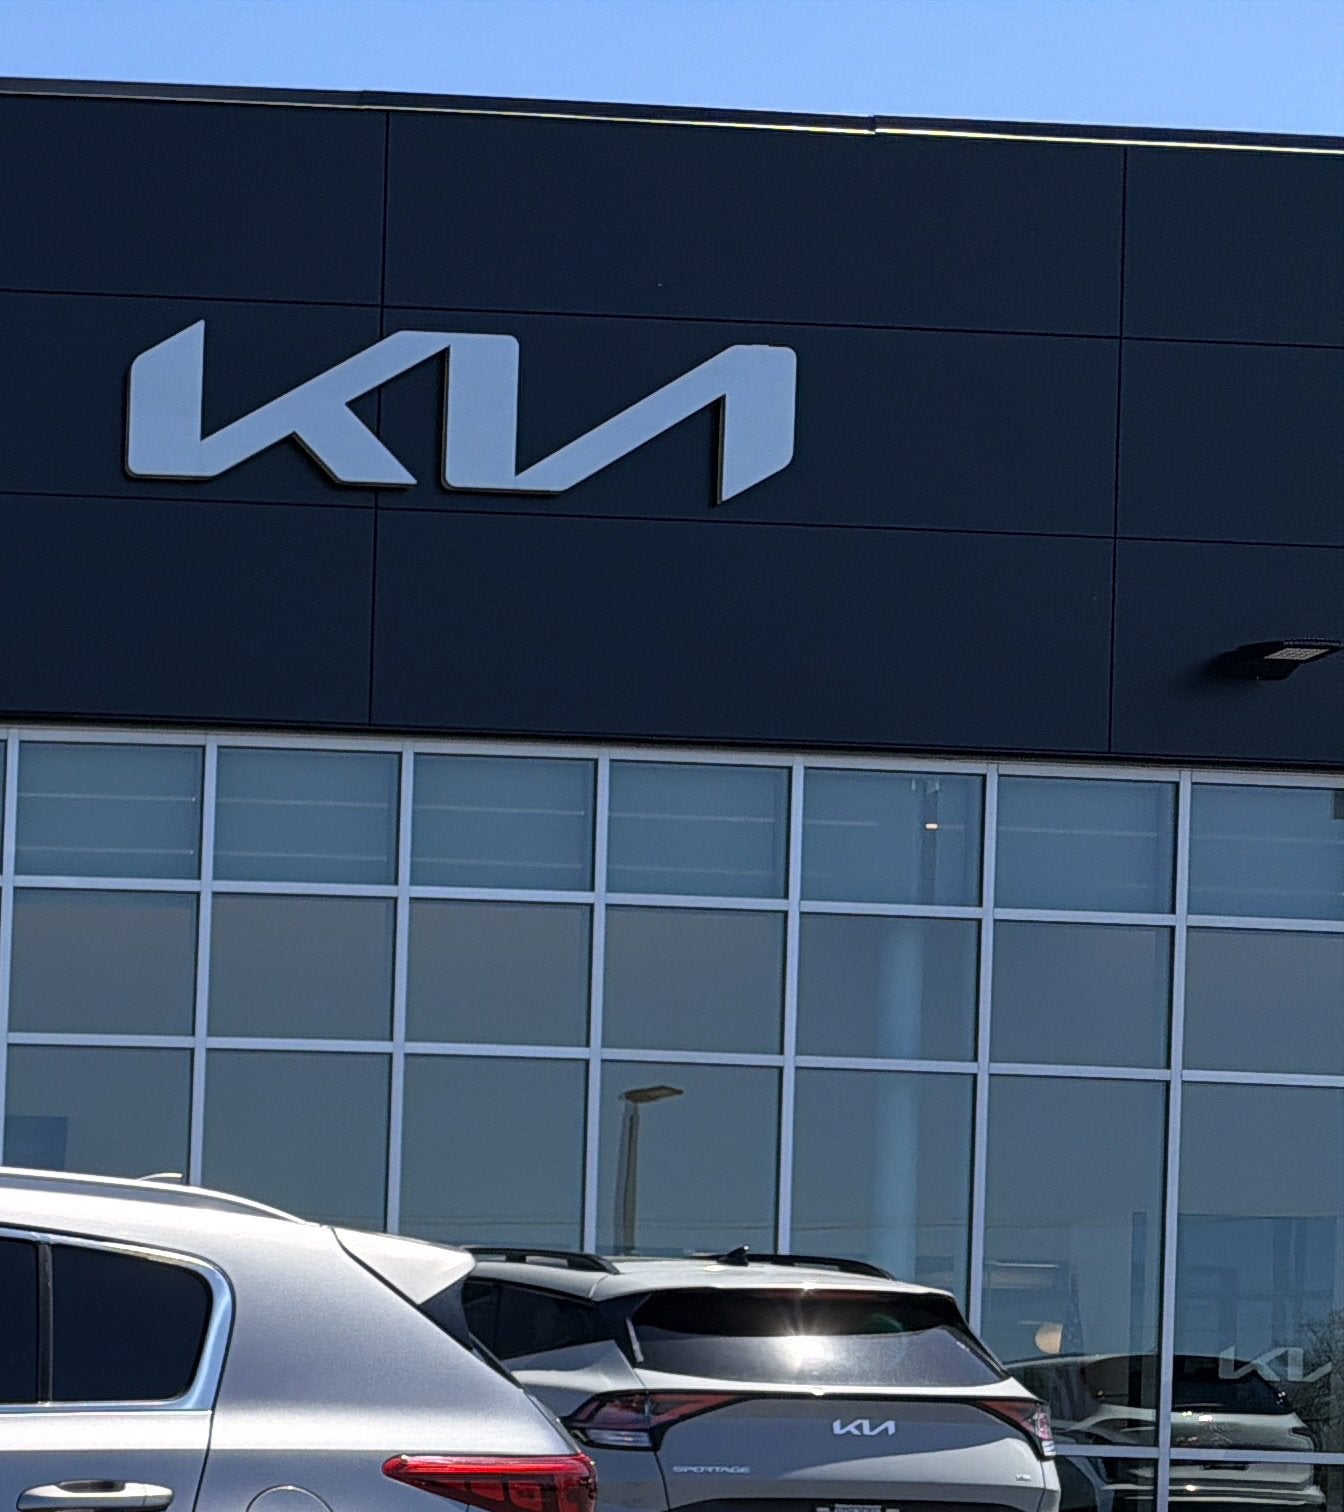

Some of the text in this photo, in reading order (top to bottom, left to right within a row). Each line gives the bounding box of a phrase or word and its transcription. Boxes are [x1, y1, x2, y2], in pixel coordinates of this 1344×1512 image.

[125, 319, 797, 504] KIA
[832, 1418, 896, 1437] KIA
[671, 1465, 751, 1474] SPORTAGE
